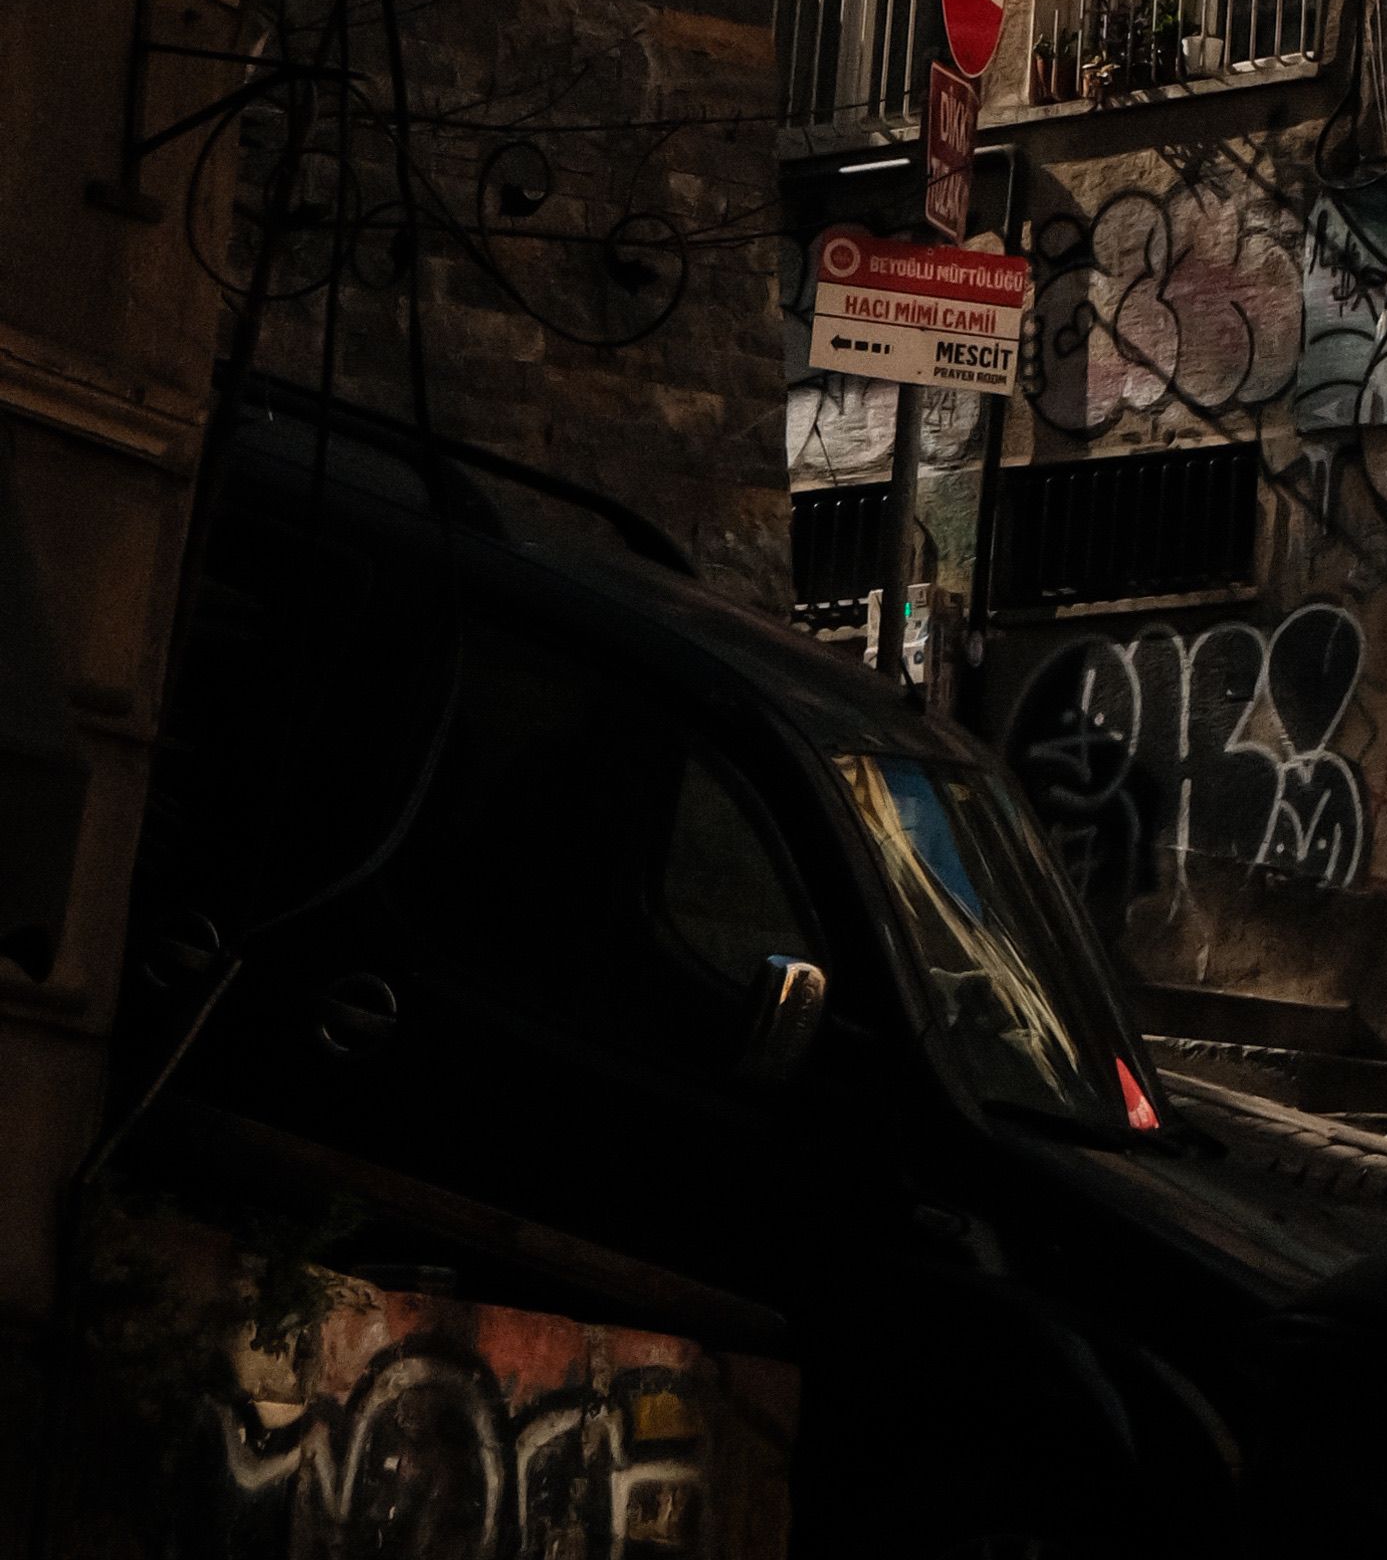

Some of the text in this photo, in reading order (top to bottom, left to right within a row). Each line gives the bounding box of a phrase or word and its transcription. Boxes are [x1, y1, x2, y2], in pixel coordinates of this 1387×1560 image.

[869, 255, 935, 281] BEYOĞLU
[845, 295, 996, 334] HACI MİMİ CAMİİ
[936, 341, 1013, 371] MESCİT
[934, 366, 1008, 385] PRAYER ROOM
